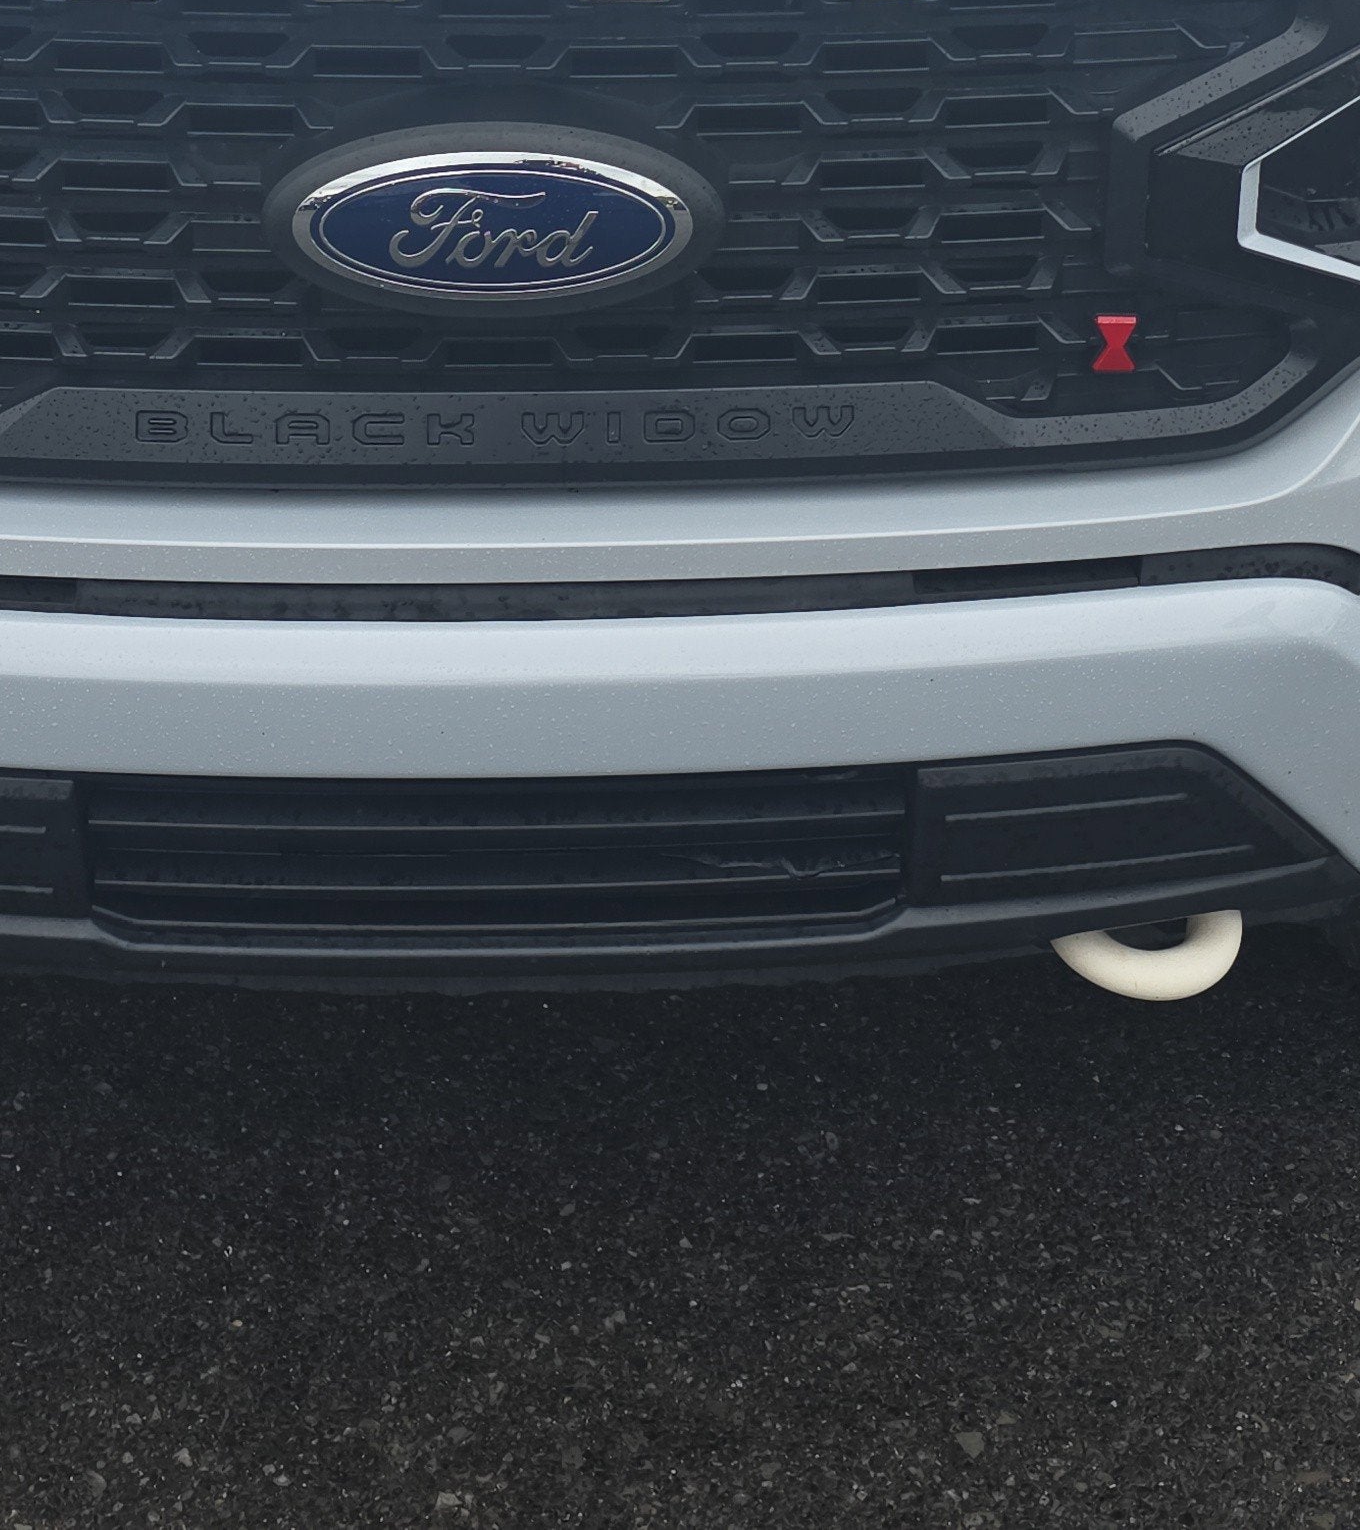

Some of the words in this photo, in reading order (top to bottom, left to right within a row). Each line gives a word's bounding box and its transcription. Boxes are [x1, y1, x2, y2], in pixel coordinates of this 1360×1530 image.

[389, 187, 599, 268] Ford
[134, 410, 476, 446] BLACK
[520, 404, 855, 446] WIDOW
